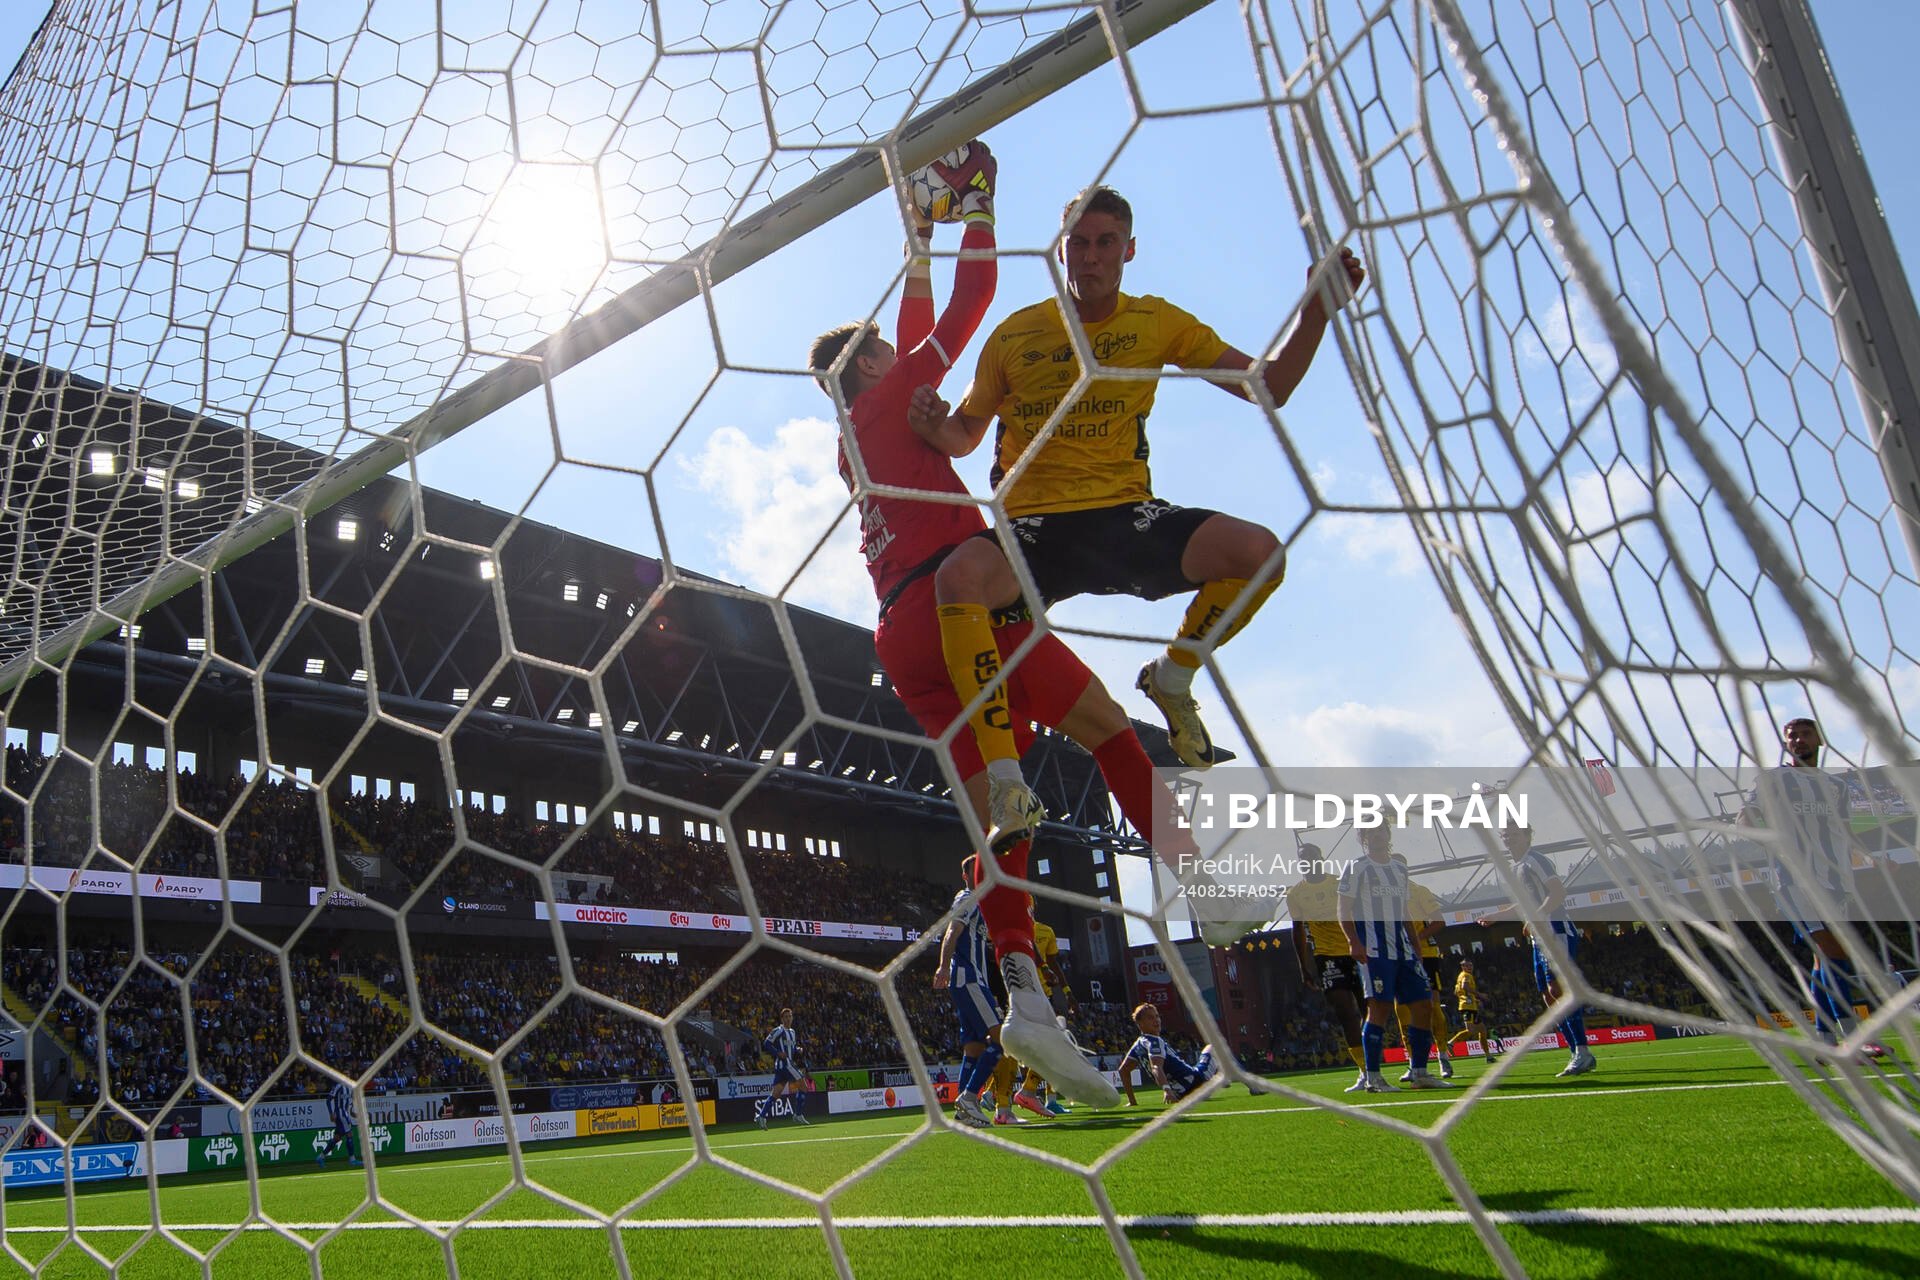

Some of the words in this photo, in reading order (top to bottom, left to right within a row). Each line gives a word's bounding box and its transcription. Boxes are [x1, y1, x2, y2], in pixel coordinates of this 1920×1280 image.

[575, 906, 628, 924] autocirc
[773, 919, 815, 935] PEAB
[254, 1105, 313, 1118] KNALLENS
[254, 1117, 313, 1131] TANDVÅRD
[210, 1136, 233, 1150] LBC
[264, 1132, 286, 1146] LBC
